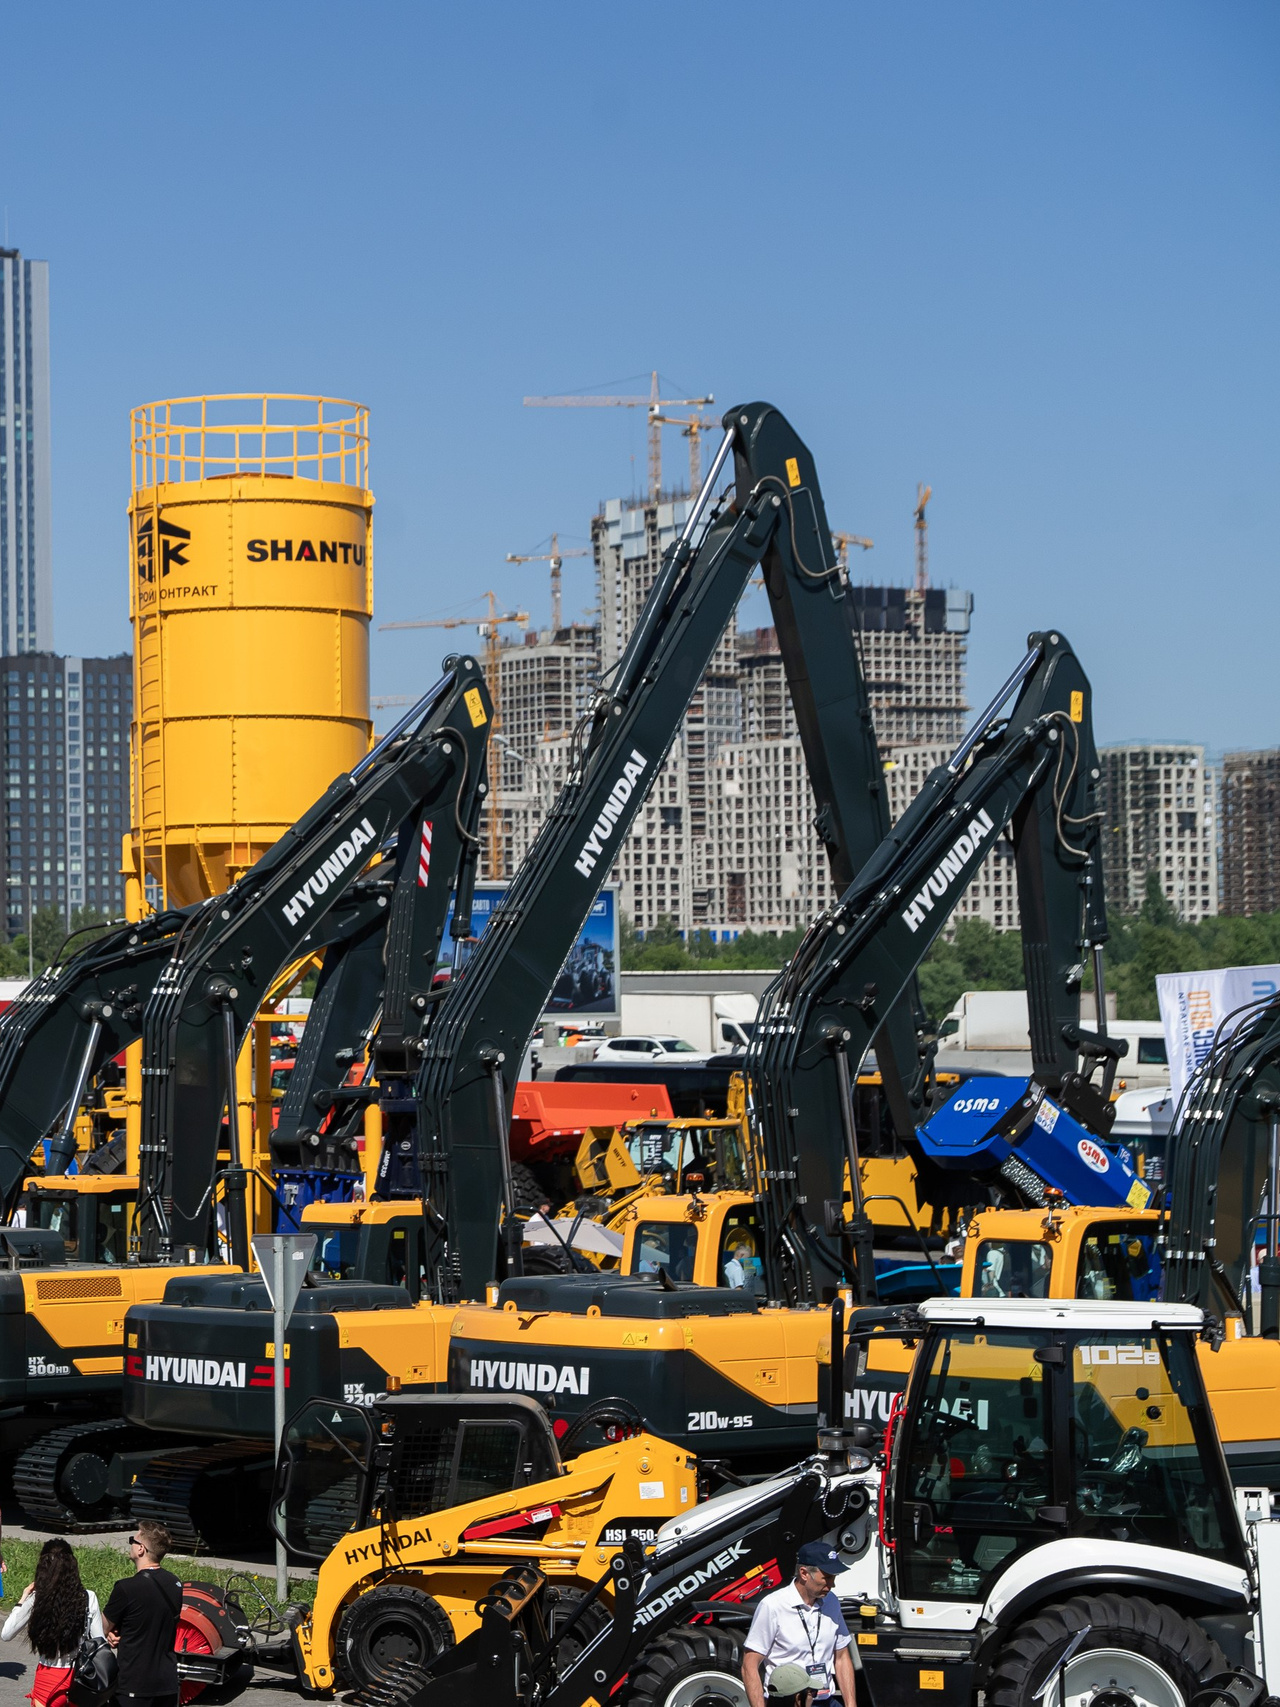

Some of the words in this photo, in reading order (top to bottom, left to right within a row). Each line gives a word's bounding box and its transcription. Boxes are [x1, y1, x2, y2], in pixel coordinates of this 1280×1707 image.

[574, 748, 648, 878] HYUNDAI
[281, 817, 377, 926] HYUNDAI
[901, 807, 995, 933] HYUNDAI
[28, 1356, 45, 1365] HX
[145, 1355, 246, 1388] HYUNDAI
[470, 1359, 590, 1395] HYUNDAI
[344, 1383, 365, 1394] HX
[844, 1388, 989, 1431] HYUDAI
[344, 1527, 433, 1566] HYUNDAI
[934, 1526, 954, 1534] K4
